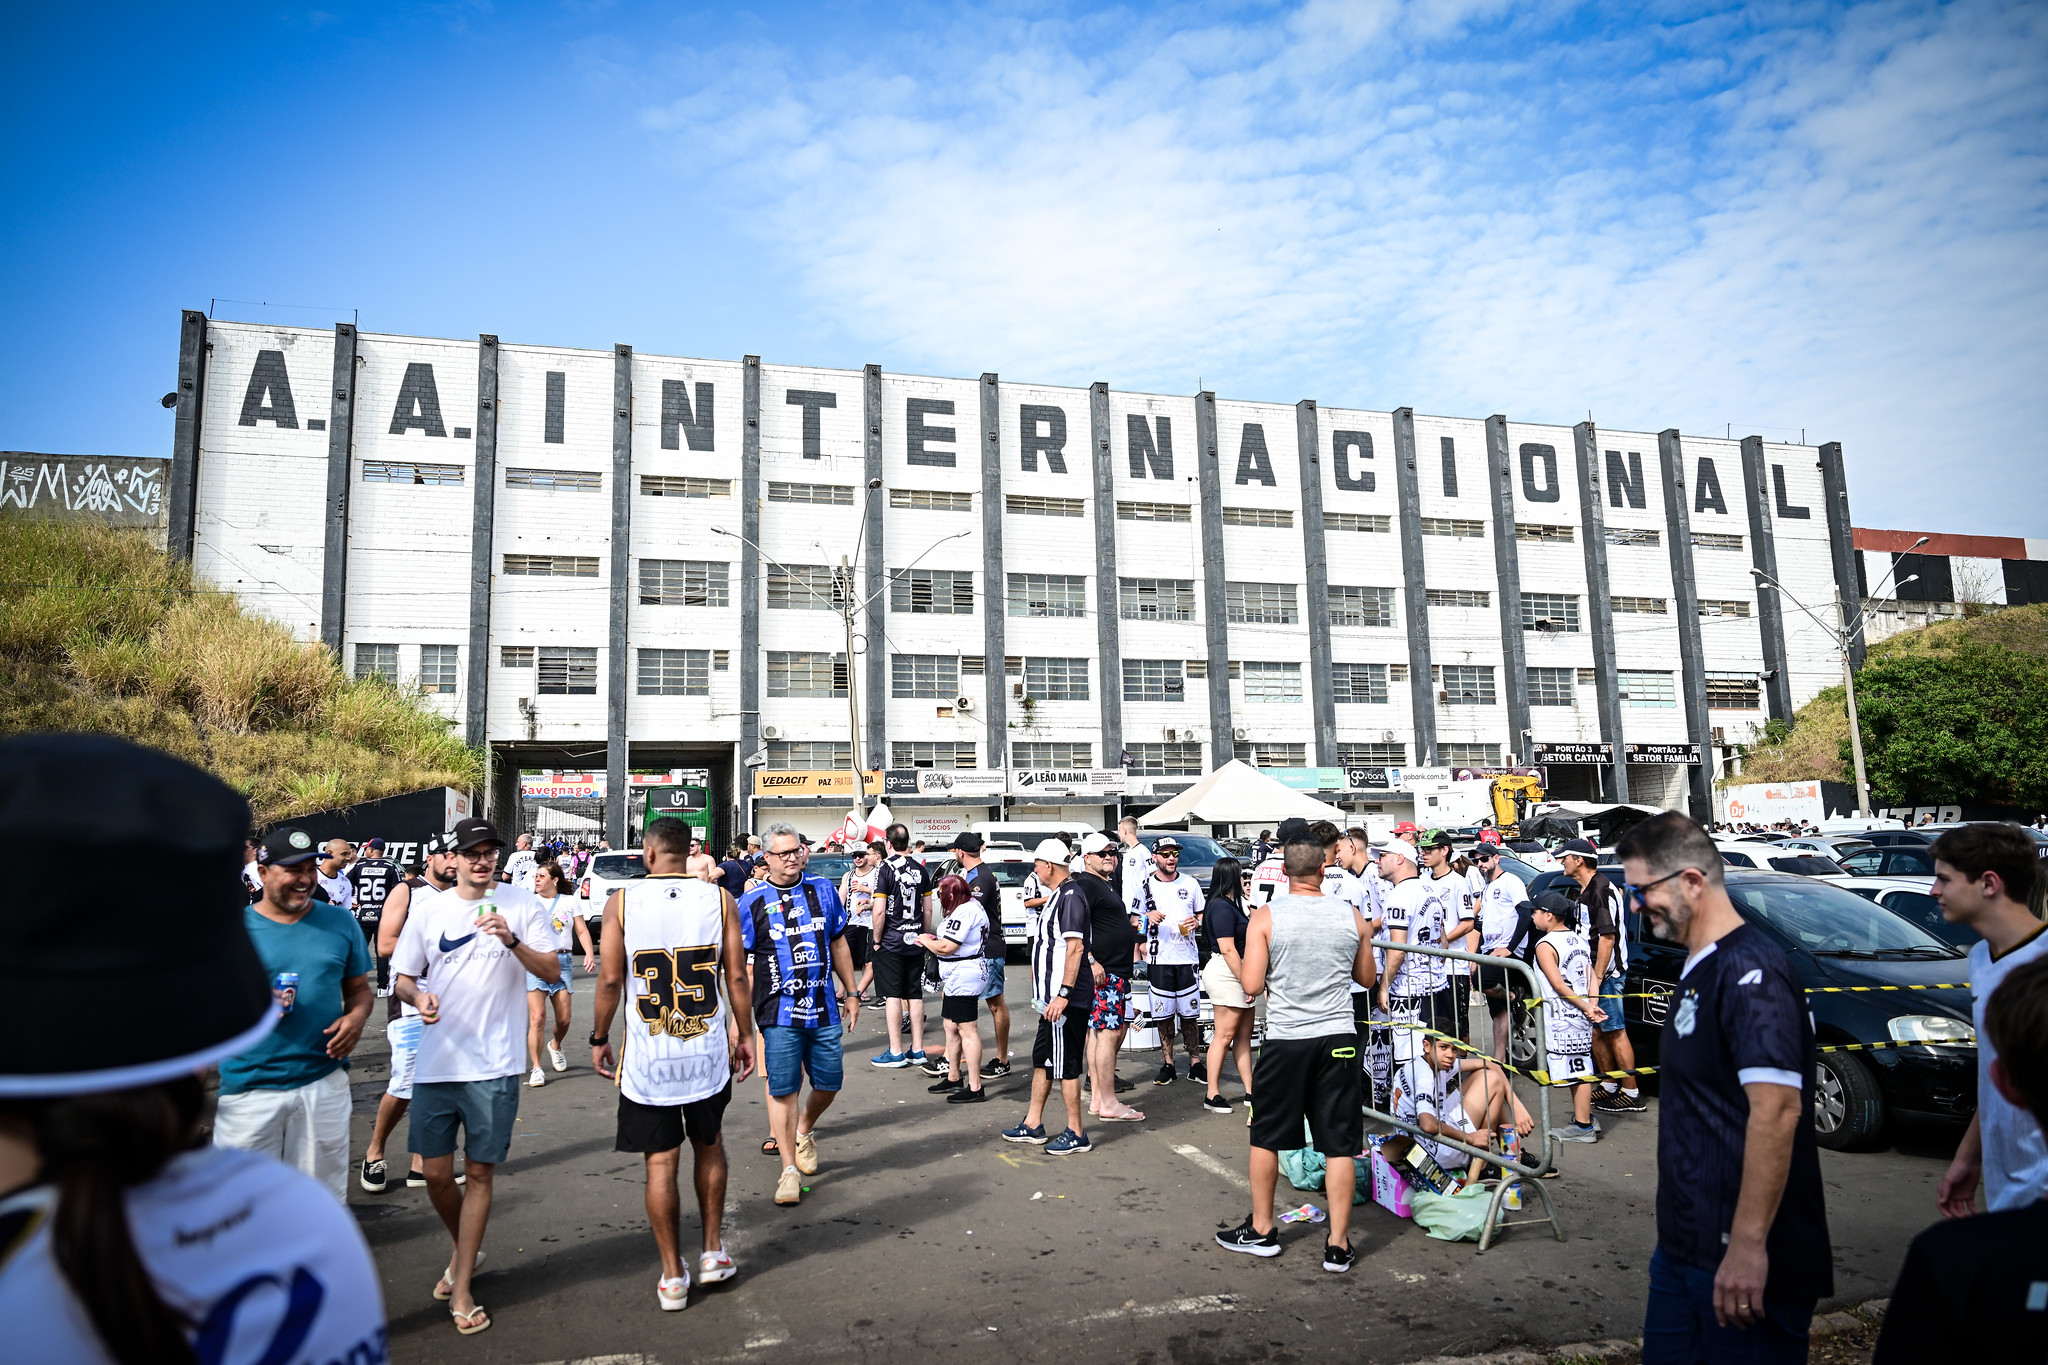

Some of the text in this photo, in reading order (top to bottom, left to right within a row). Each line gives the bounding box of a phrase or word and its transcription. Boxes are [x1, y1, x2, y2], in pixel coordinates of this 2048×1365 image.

[1555, 744, 1585, 753] PORTÃO
[1647, 745, 1676, 754] PORTÃO
[1542, 753, 1608, 763] SETOR CATIVA
[1632, 753, 1662, 763] SETOR
[762, 776, 809, 785] VEDACIT
[1035, 770, 1057, 783] LEÃO
[1403, 773, 1448, 781] gobank.com.br
[818, 778, 832, 787] PAZ
[522, 784, 592, 798] Savegnago
[359, 878, 386, 901] 26
[1259, 884, 1275, 903] 7
[794, 950, 817, 964] BRZ
[633, 944, 718, 1023] 35
[1569, 1057, 1586, 1074] 19
